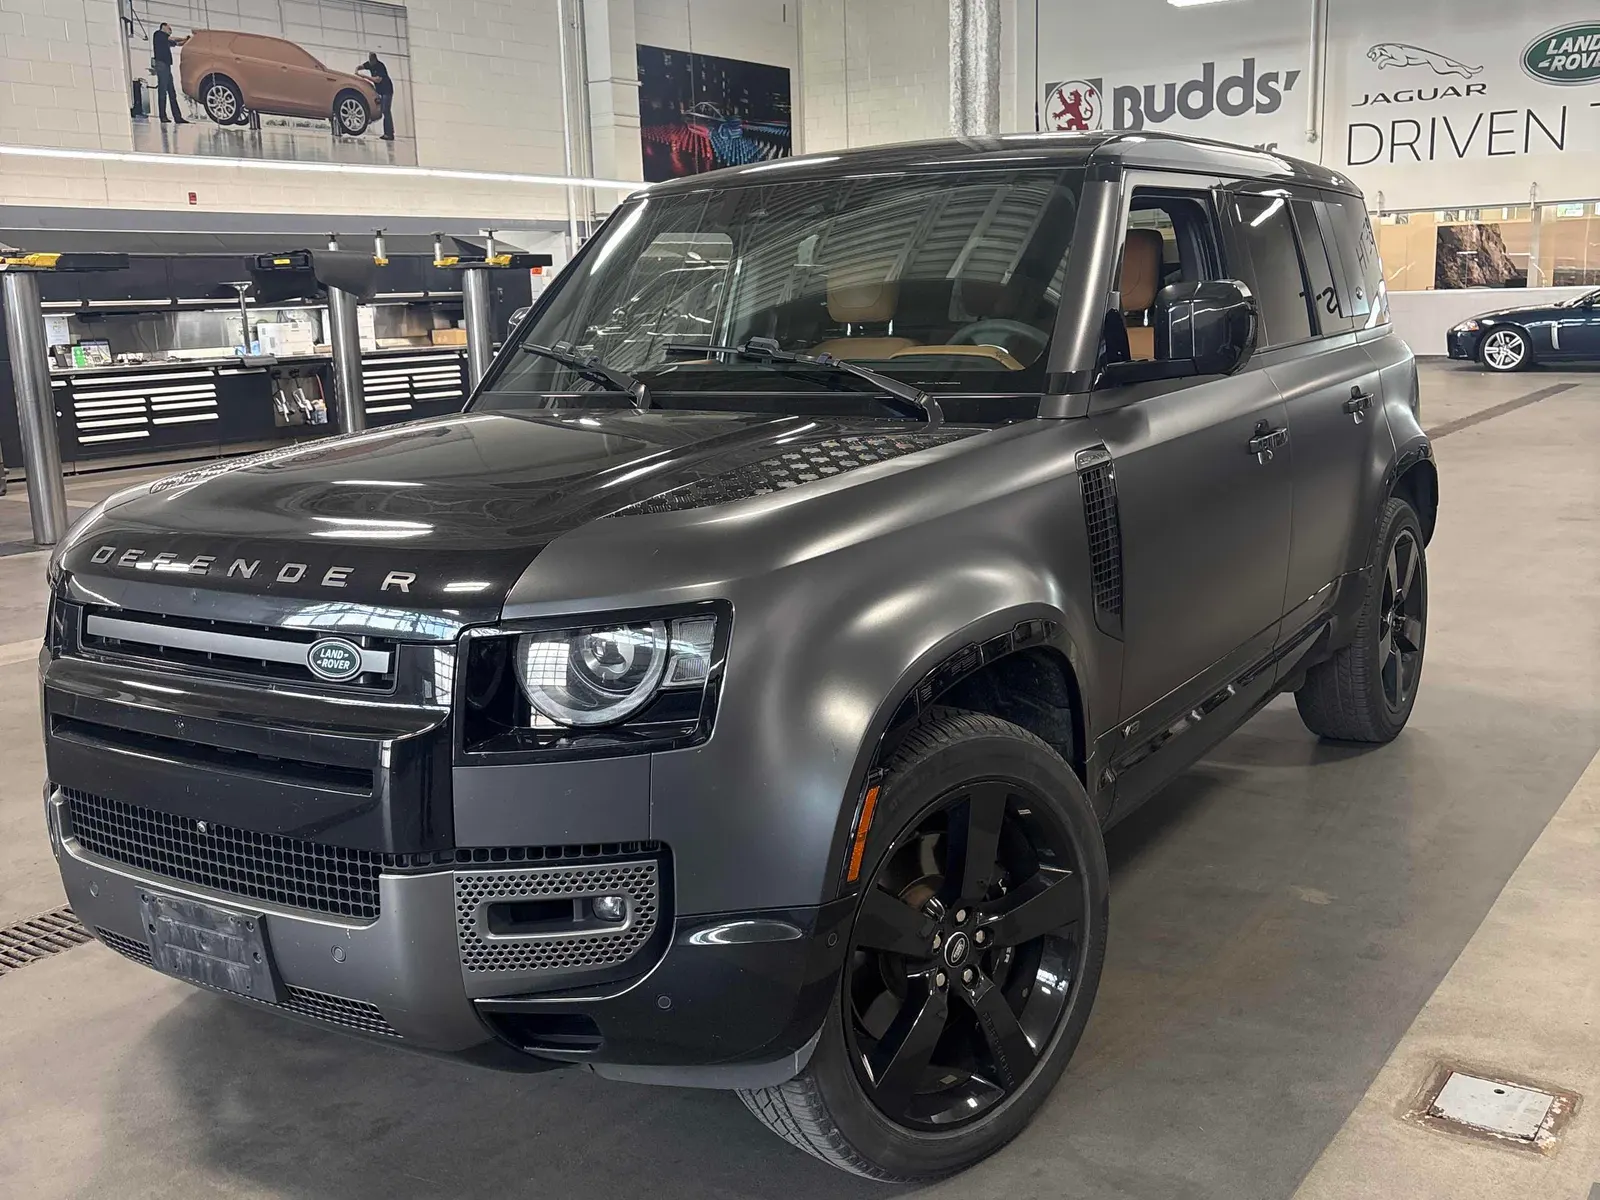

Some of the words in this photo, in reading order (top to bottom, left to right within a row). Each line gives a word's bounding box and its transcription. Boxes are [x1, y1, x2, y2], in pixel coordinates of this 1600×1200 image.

[1546, 34, 1600, 56] LAND
[1351, 83, 1487, 107] JAGUAR
[1347, 105, 1567, 167] DRIVEN
[90, 546, 417, 593] DEFENDER
[320, 648, 344, 660] LAND
[321, 659, 350, 670] ROVER
